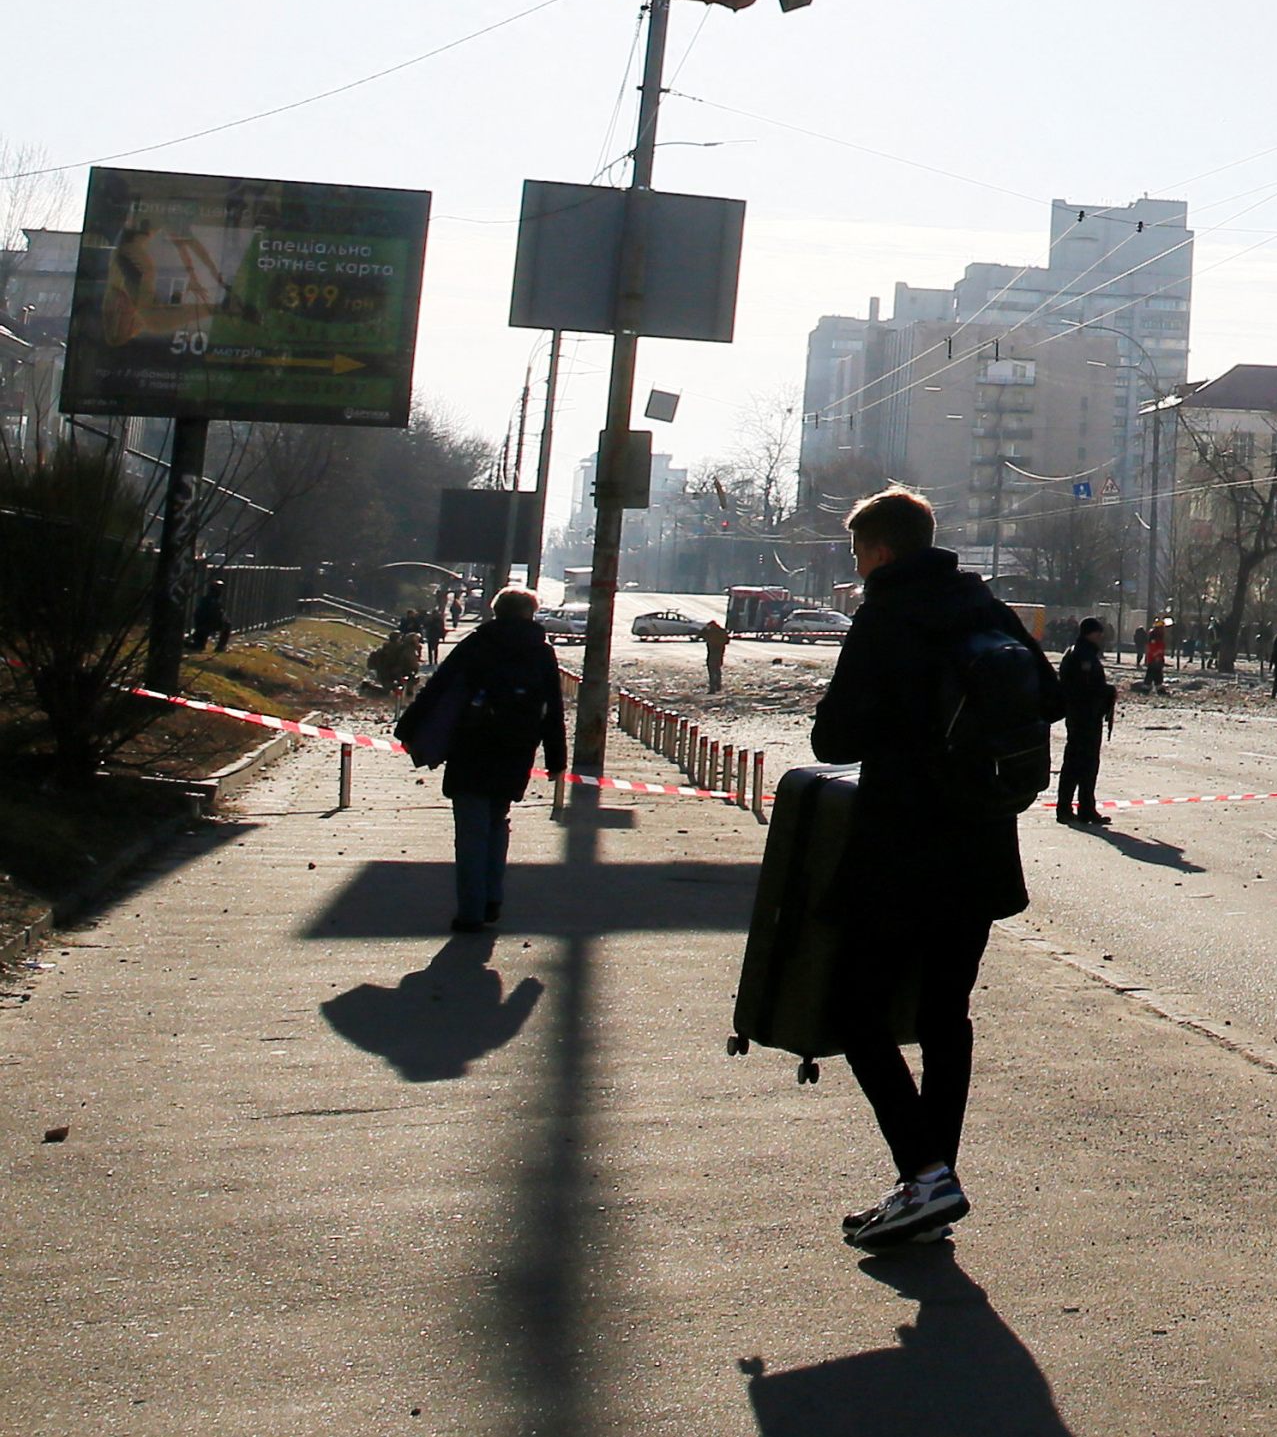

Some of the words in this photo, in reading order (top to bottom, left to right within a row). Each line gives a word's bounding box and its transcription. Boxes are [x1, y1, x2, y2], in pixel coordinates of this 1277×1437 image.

[260, 240, 373, 257] спеціальна
[257, 255, 329, 272] фітнес
[335, 263, 394, 277] карта
[283, 283, 339, 309] 399
[171, 331, 208, 356] 50
